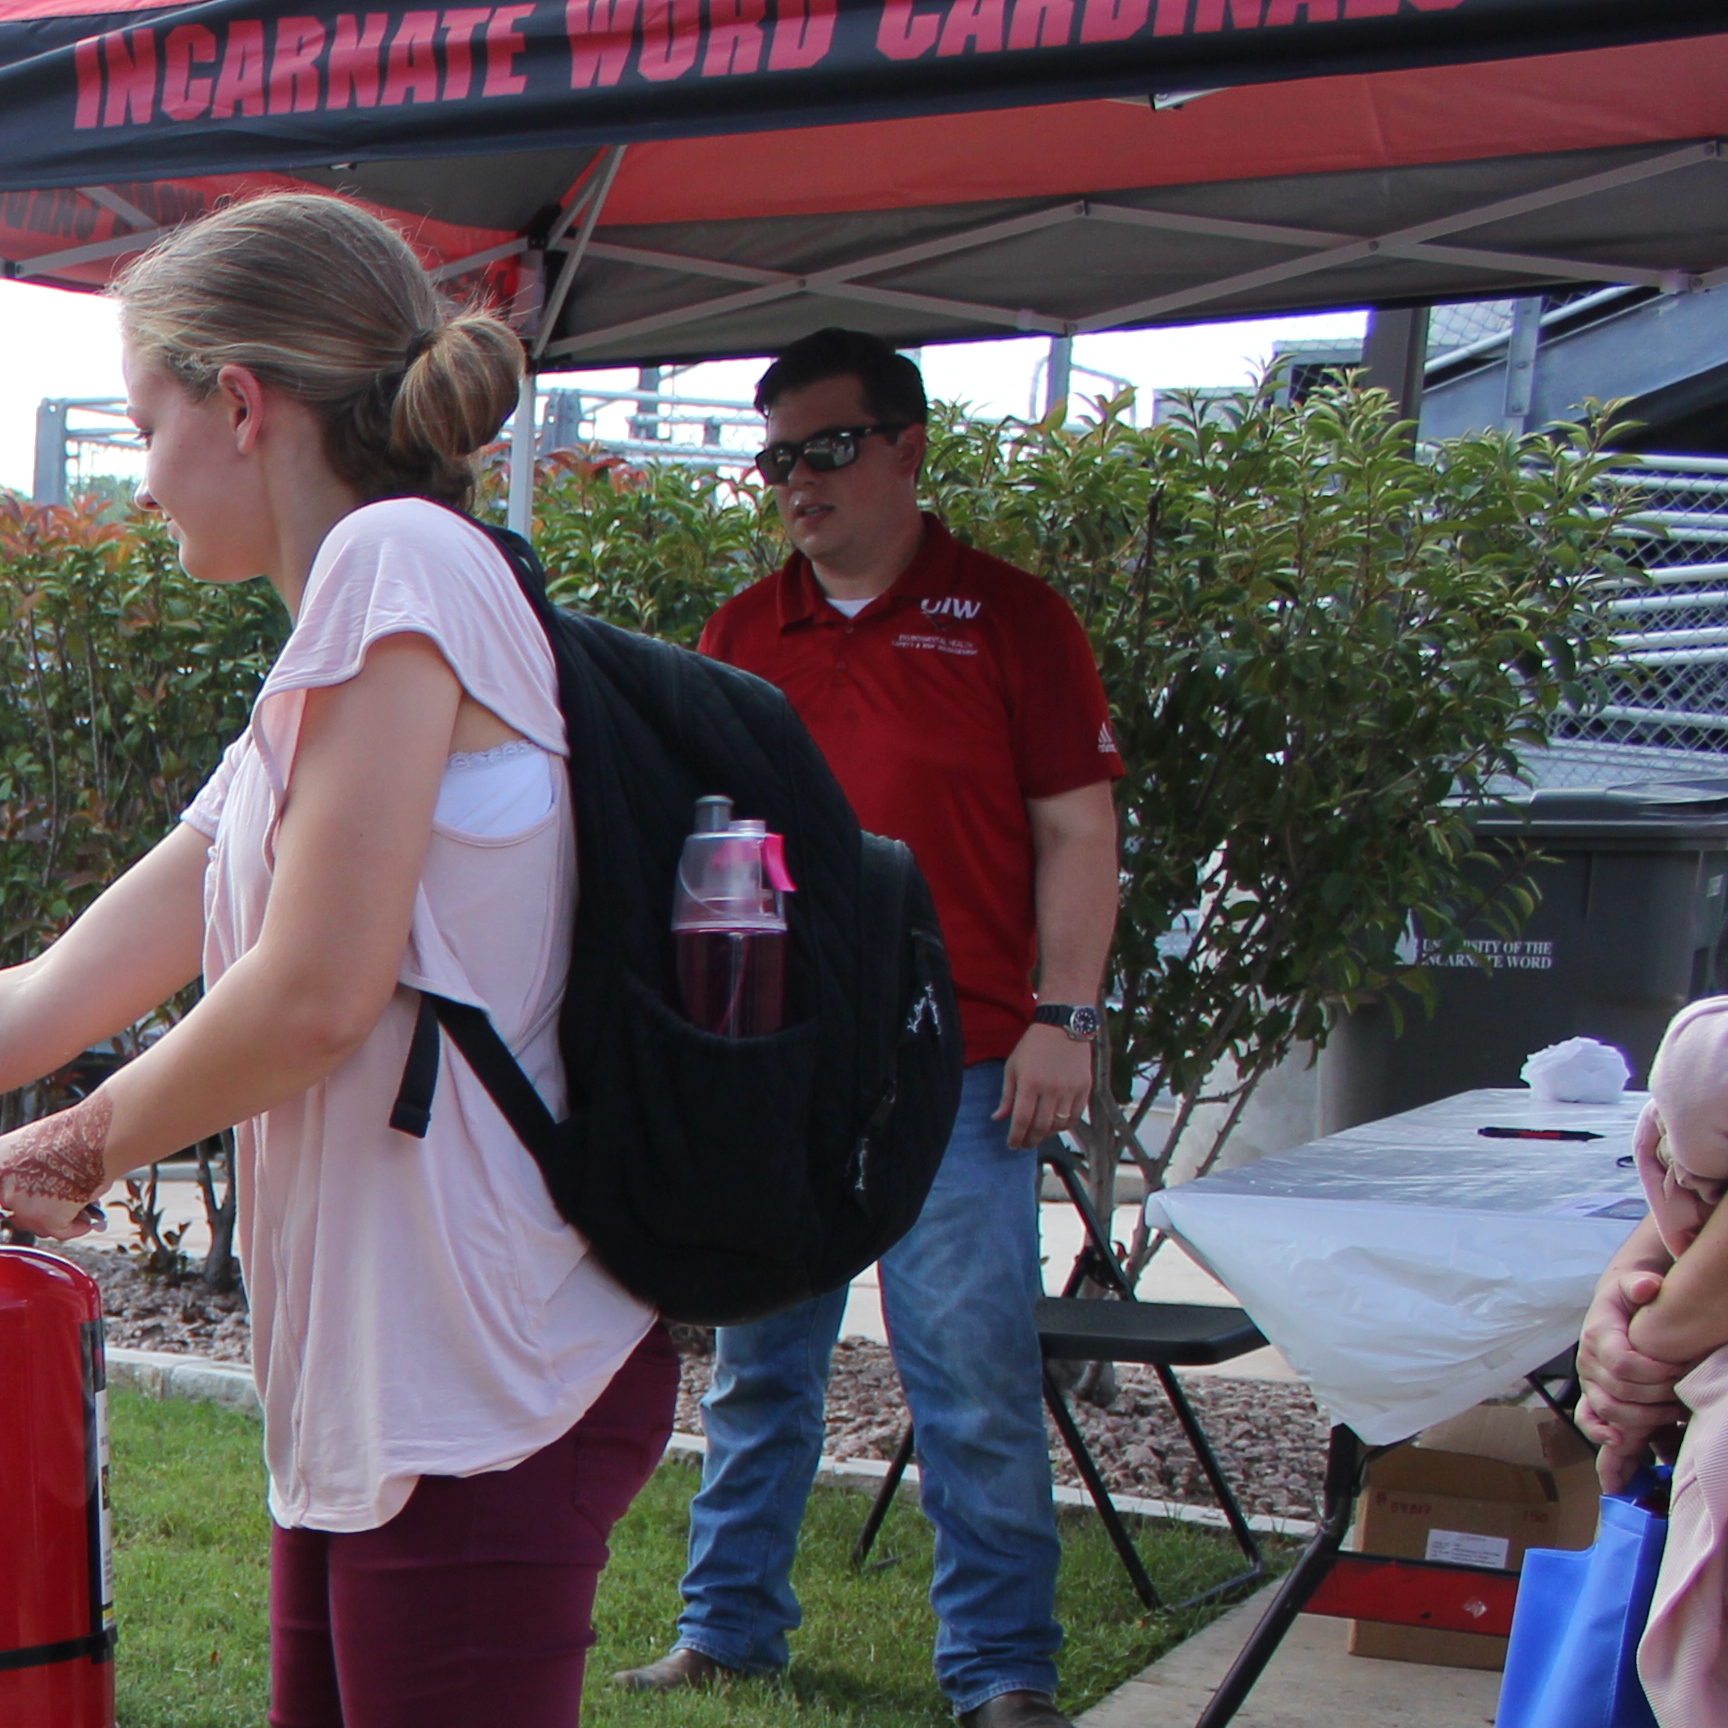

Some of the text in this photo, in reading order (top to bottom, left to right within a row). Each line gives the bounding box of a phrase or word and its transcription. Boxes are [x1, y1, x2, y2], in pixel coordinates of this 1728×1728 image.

[72, 3, 538, 131] INCARNATE
[565, 0, 839, 92] WORD
[920, 597, 982, 619] UIW
[1422, 938, 1553, 955] UNSITY OF THE
[1506, 955, 1553, 969] WORD
